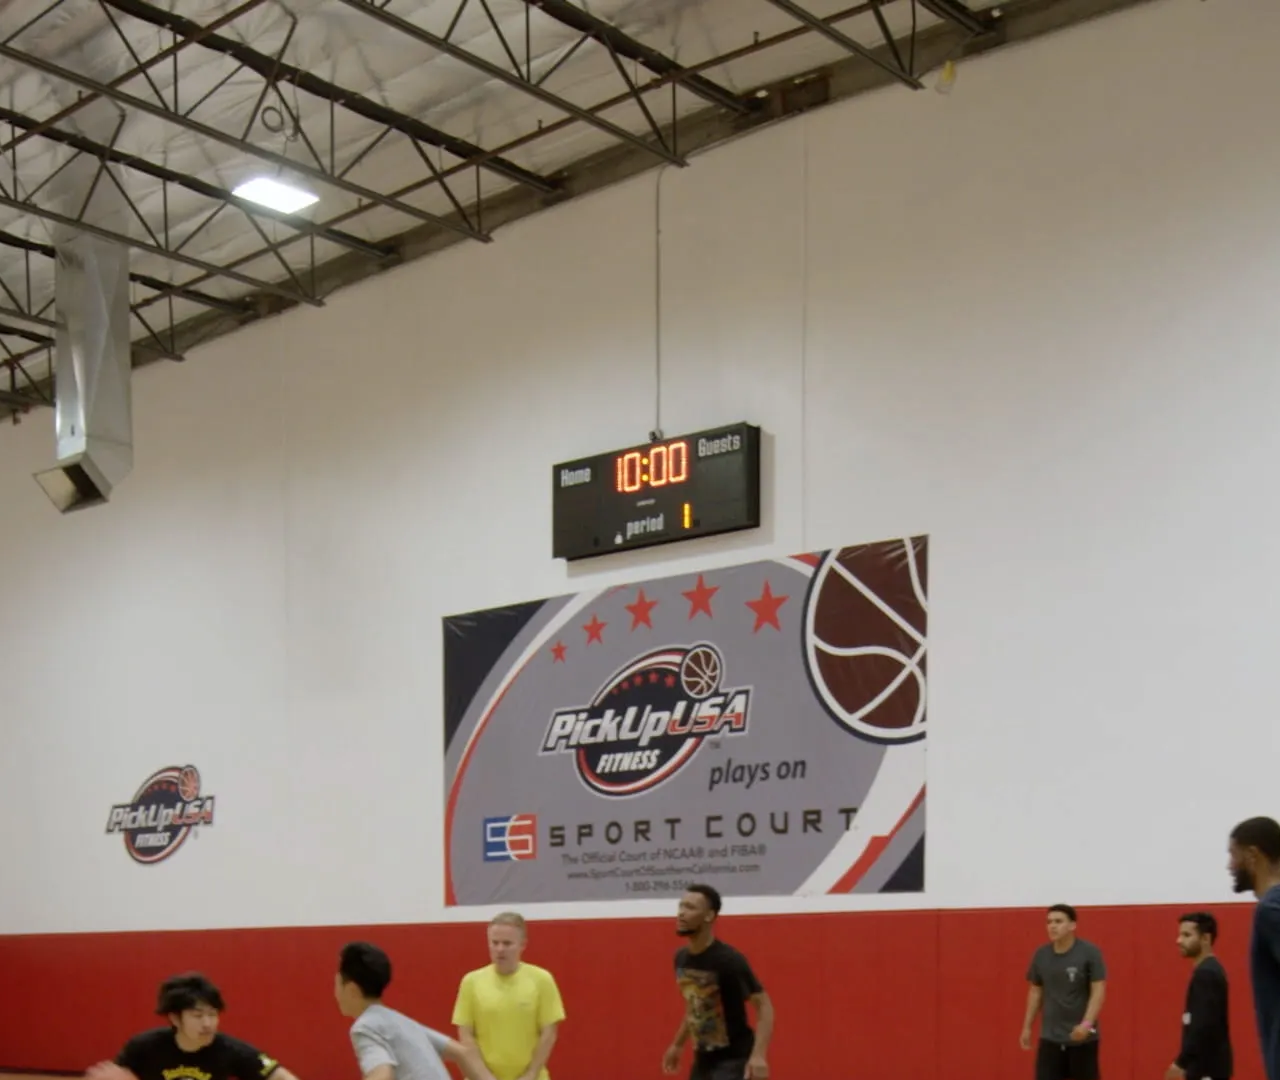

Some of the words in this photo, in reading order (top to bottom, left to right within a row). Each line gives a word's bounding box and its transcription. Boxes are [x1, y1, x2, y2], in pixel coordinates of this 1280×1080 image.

[698, 434, 741, 458] Guests
[561, 467, 591, 487] Home
[617, 442, 687, 492] 10:00
[626, 513, 664, 539] period
[683, 503, 691, 529] 1
[596, 750, 661, 774] FITNESS
[708, 758, 770, 791] plays
[777, 759, 807, 780] on
[549, 818, 682, 848] SPORT
[705, 808, 858, 839] COURT
[562, 853, 579, 864] The
[582, 851, 616, 864] Official
[619, 850, 647, 862] Court
[708, 845, 728, 858] and
